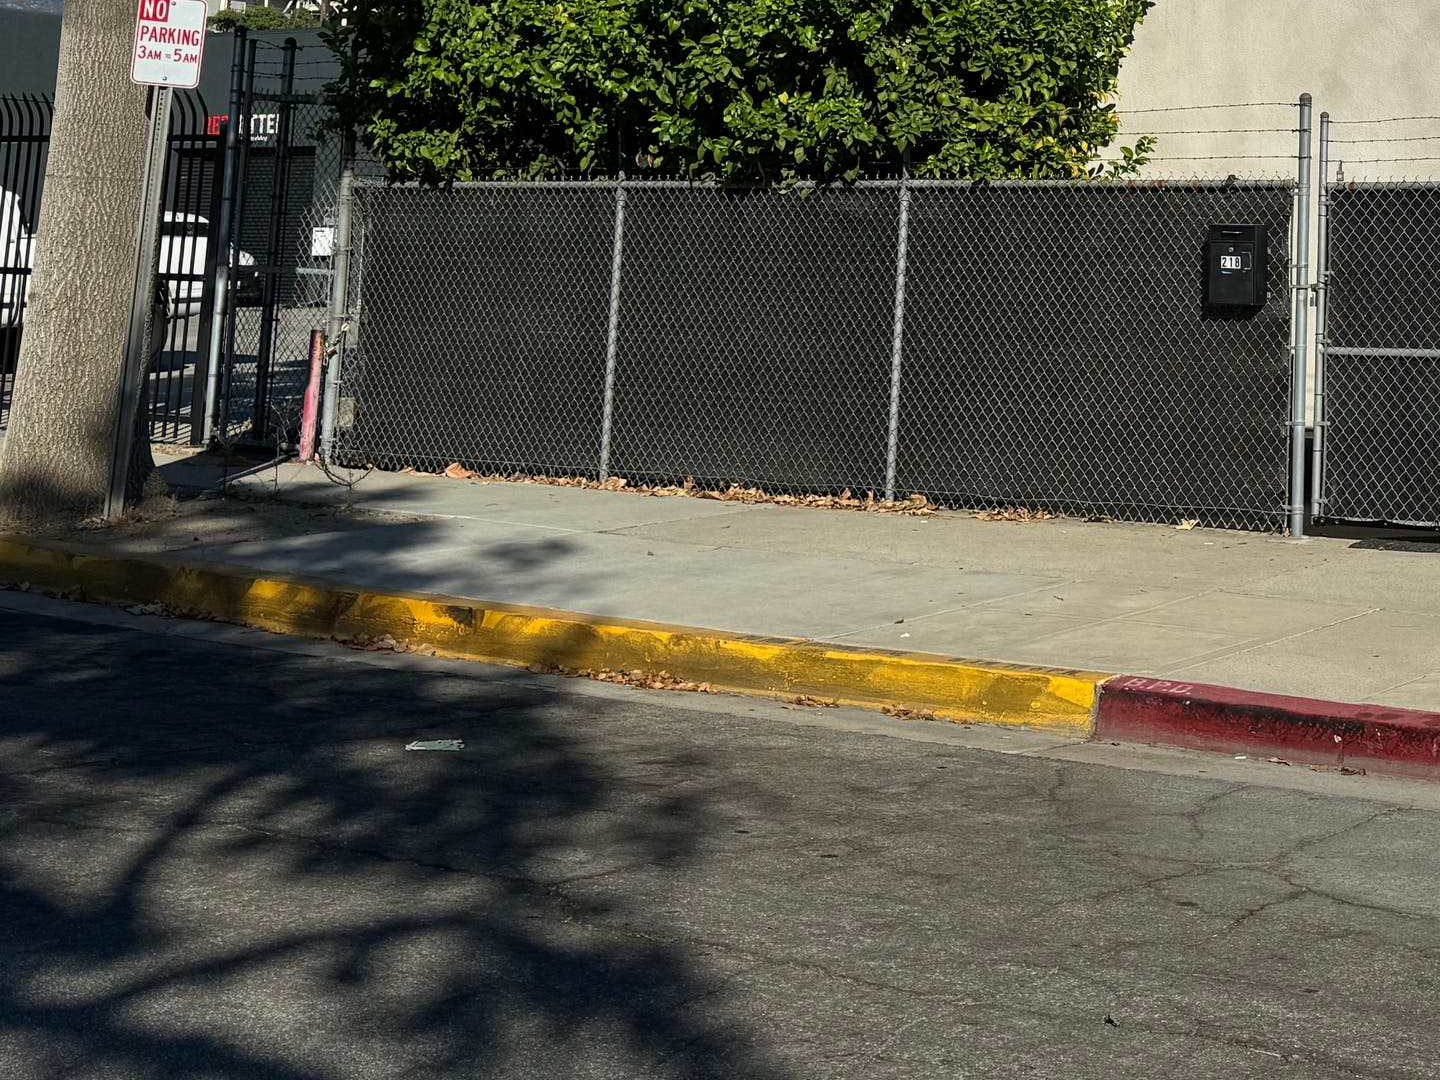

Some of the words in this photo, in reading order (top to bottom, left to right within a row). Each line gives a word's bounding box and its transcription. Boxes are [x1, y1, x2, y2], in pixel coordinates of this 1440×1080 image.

[143, 0, 167, 20] NO
[140, 25, 200, 46] PARKING
[138, 45, 162, 61] 3AM
[173, 48, 198, 64] 5AM
[1222, 256, 1240, 268] 218
